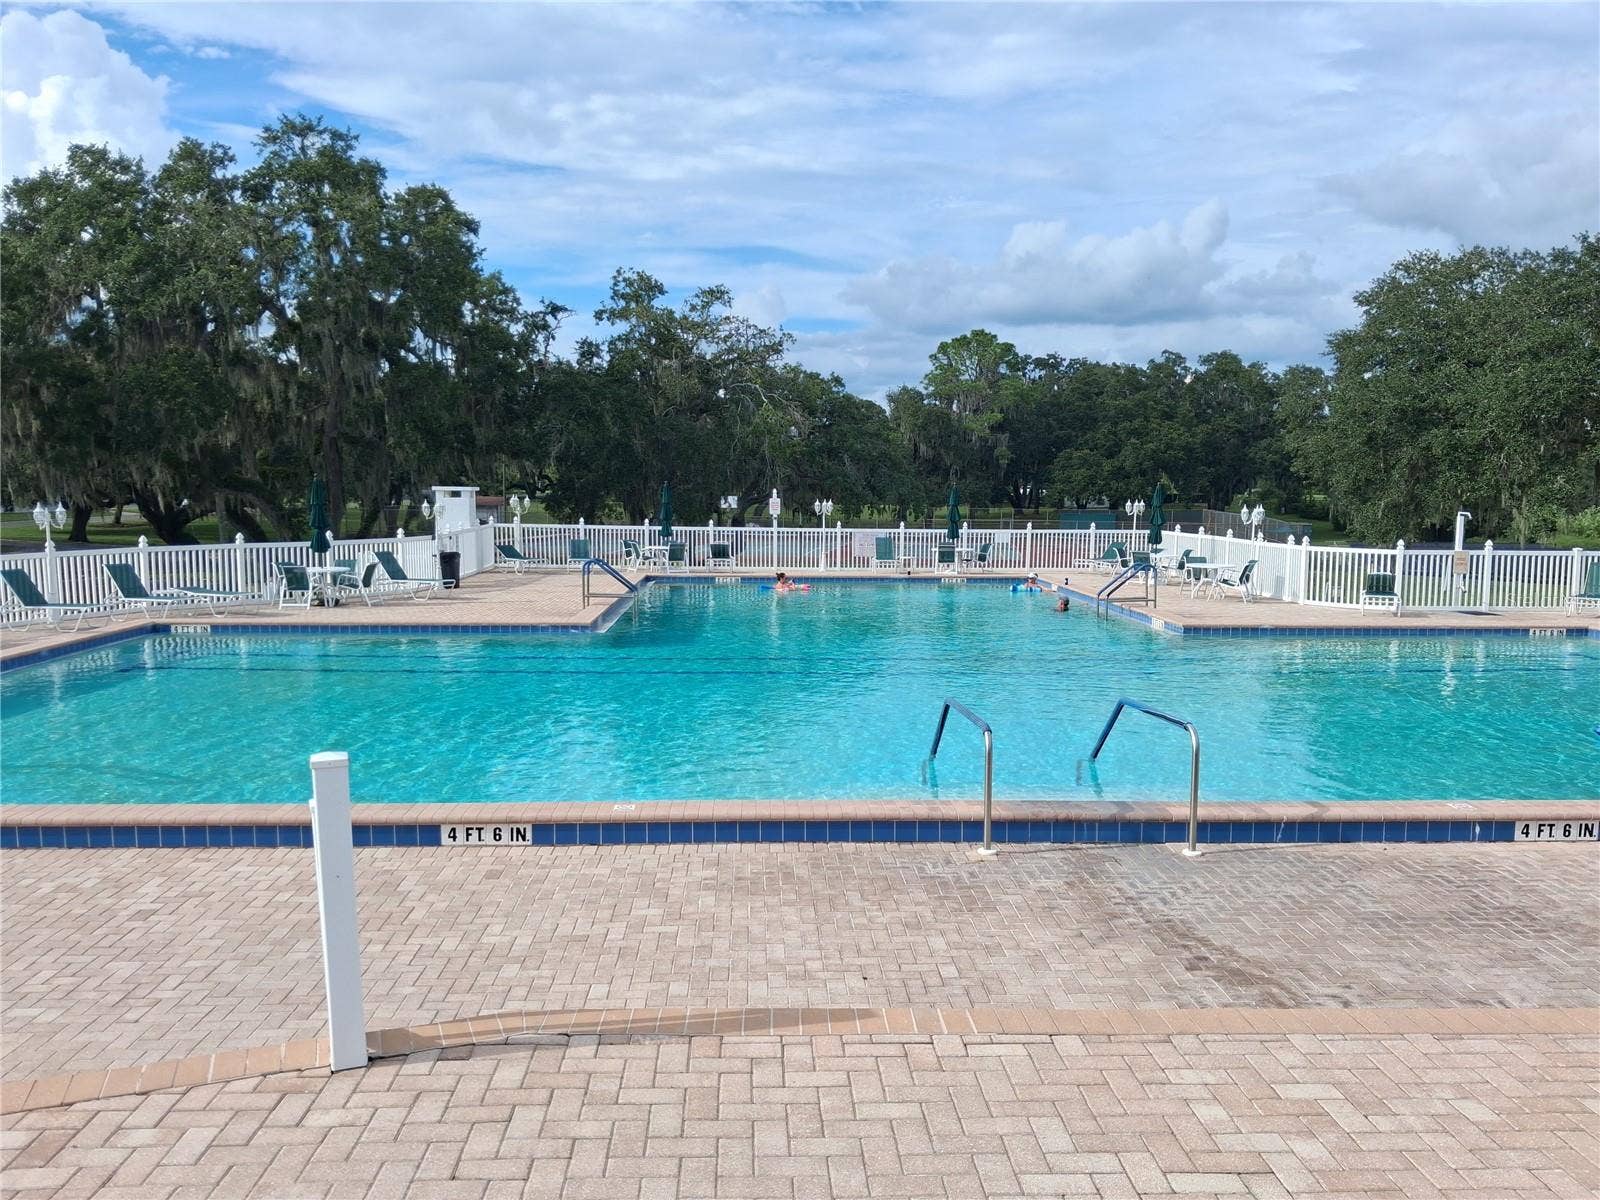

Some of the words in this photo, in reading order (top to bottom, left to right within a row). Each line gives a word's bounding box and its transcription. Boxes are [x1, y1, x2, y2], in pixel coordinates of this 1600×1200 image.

[447, 826, 458, 842] 4
[465, 826, 485, 842] FT.
[493, 826, 503, 842] 6
[510, 826, 530, 842] IN.
[1521, 823, 1530, 838] 4
[1537, 823, 1555, 838] FT.
[1562, 823, 1572, 838] 6
[1578, 823, 1597, 838] IN.
